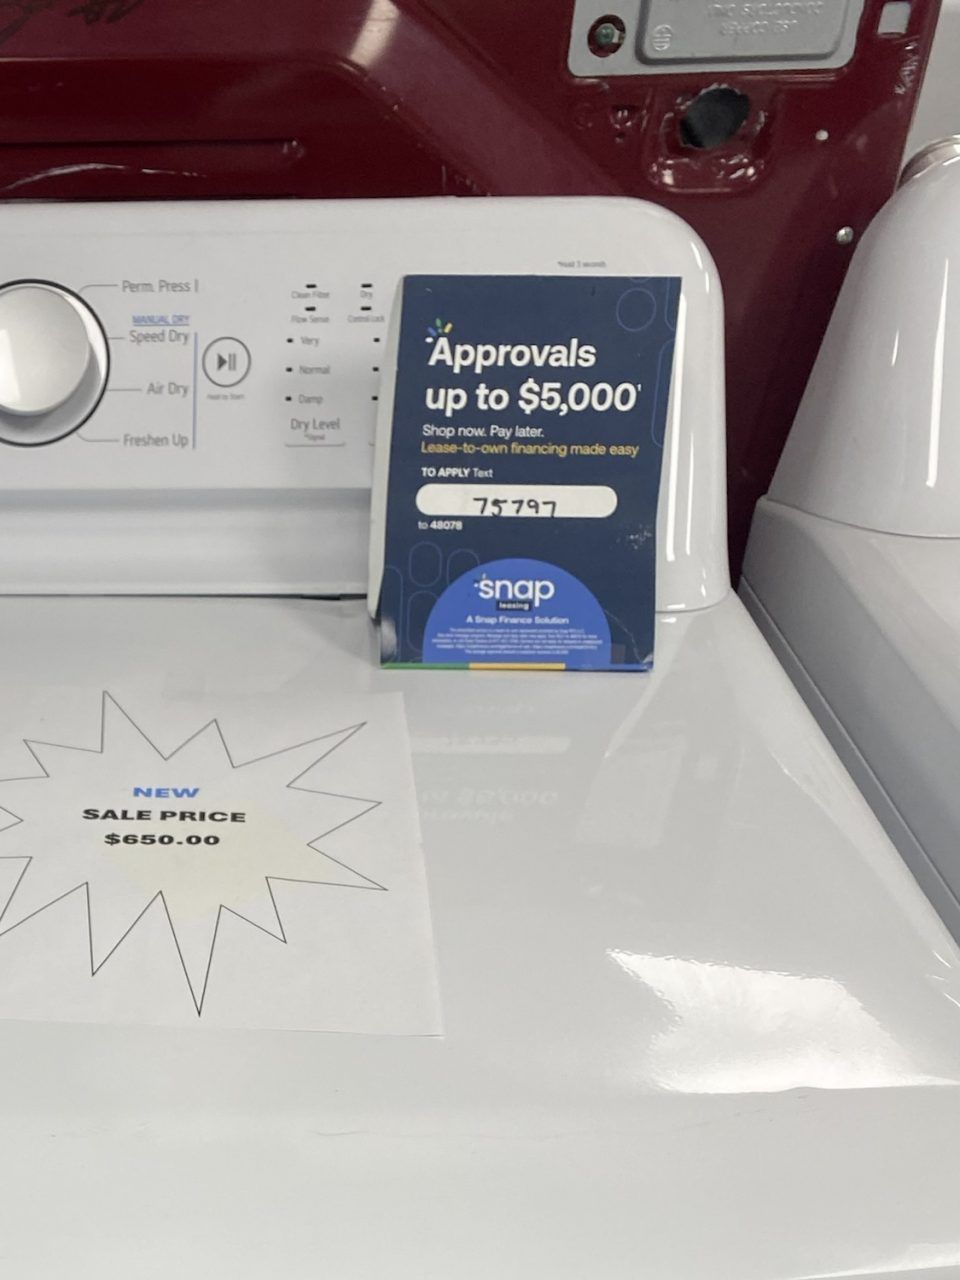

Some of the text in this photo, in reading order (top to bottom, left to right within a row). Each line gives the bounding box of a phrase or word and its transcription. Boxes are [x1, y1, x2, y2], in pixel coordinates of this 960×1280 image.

[122, 279, 191, 293] Perm. Press
[360, 290, 373, 300] Dry
[132, 314, 190, 325] MANUAL DRY
[129, 329, 189, 345] Speed Dry
[300, 336, 319, 347] Very
[427, 336, 597, 374] Approvals
[299, 365, 330, 375] Normal
[146, 382, 188, 398] Air Dry
[298, 394, 324, 405] Damp
[424, 387, 468, 417] up
[475, 383, 509, 411] to
[290, 417, 340, 432] Dry Level
[422, 424, 544, 440] Shop now. Pay later.
[123, 433, 189, 449] Freshen Up
[421, 441, 640, 457] Lease-to-own financing made easy
[421, 467, 493, 478] TO APPLY Text
[473, 497, 557, 517] 75797
[418, 520, 428, 530] to
[477, 577, 555, 607] snap
[499, 601, 530, 611] leasing
[466, 615, 569, 625] A Snap Finance Solution
[133, 787, 200, 798] NEW
[82, 808, 246, 823] SALE PRICE
[104, 832, 220, 846] $650.00
